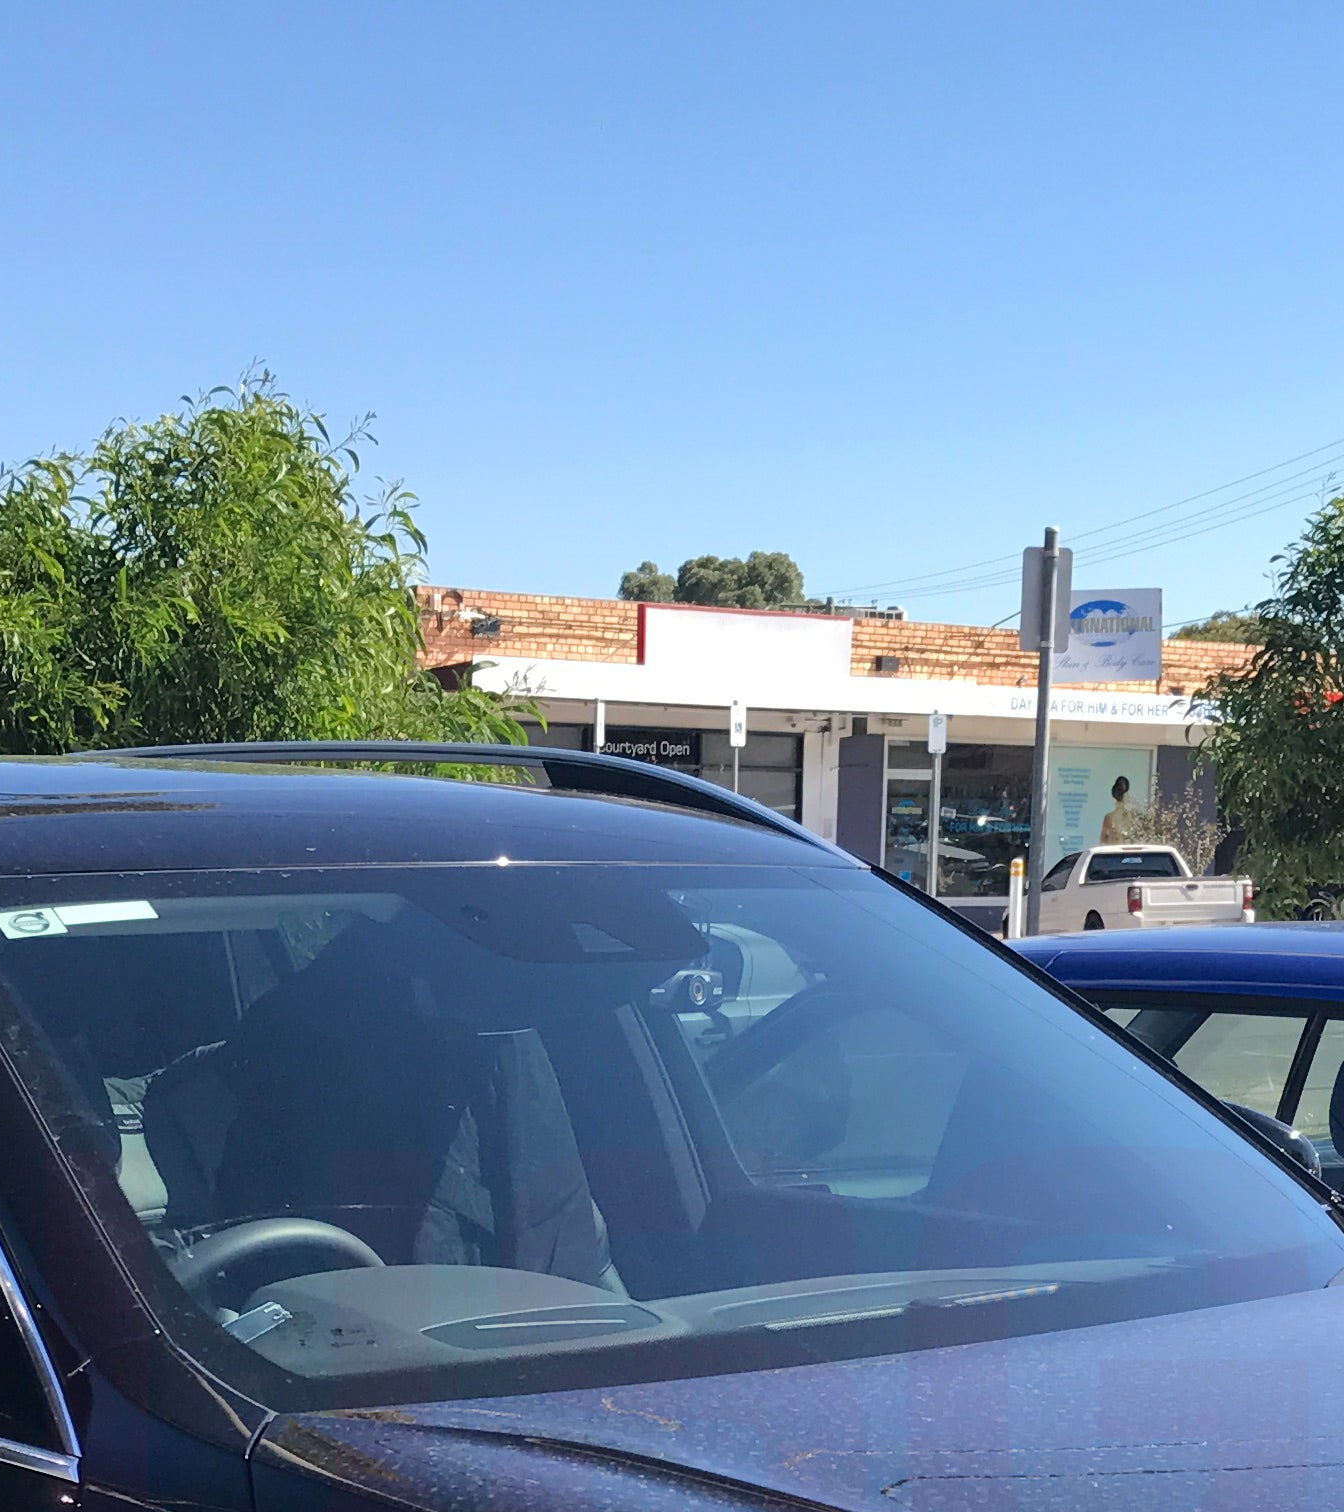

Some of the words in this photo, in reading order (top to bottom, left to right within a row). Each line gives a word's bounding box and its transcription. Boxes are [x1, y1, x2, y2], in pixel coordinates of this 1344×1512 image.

[1011, 697, 1032, 711] DAY
[1061, 700, 1084, 714] FOR
[1087, 702, 1108, 714] HIM
[1111, 704, 1118, 715] &
[1121, 703, 1144, 716] FOR
[1147, 704, 1169, 717] HER
[660, 740, 690, 756] Open
